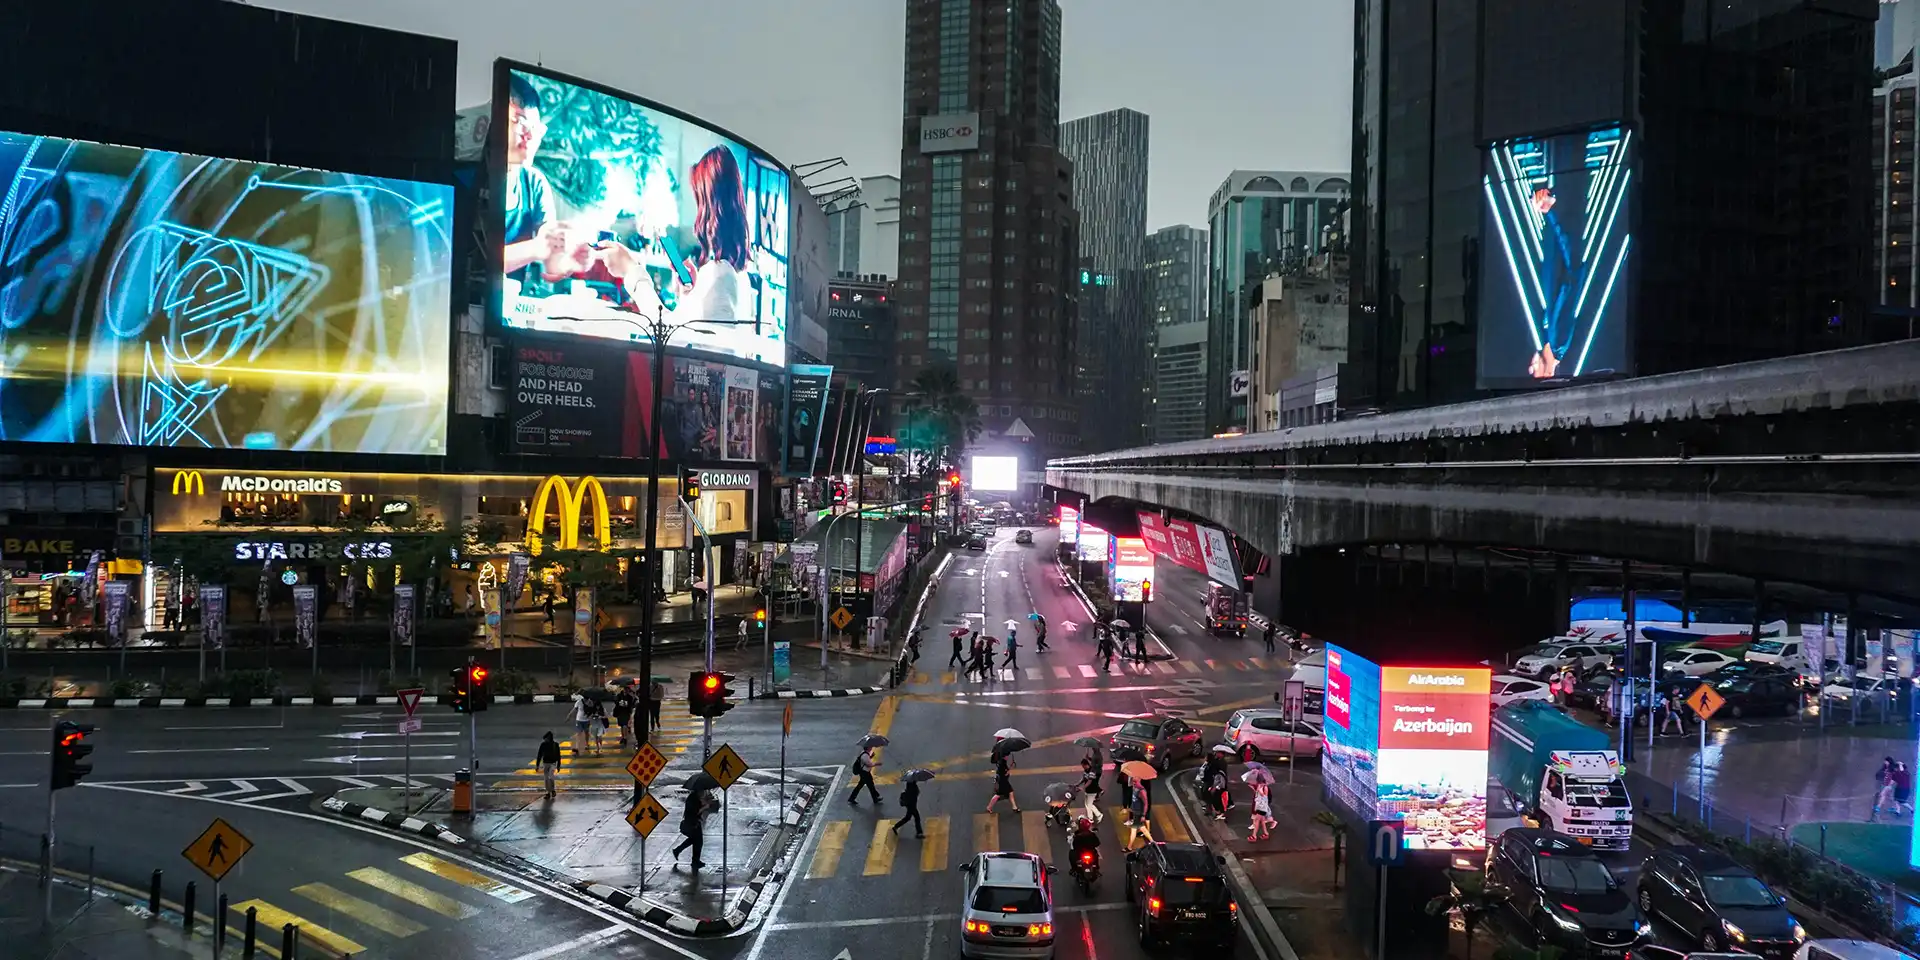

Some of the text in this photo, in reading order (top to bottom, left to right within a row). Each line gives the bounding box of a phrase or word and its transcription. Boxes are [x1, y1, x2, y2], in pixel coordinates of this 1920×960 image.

[923, 127, 955, 140] HSBC
[518, 361, 595, 381] FOR CHOICE
[518, 377, 583, 393] AND HEAD
[517, 391, 597, 408] OVER HEELS.
[564, 428, 592, 436] SHOWING
[221, 476, 343, 493] McDonald's
[701, 472, 751, 487] GIORDANO
[4, 537, 74, 554] BAKE
[1407, 674, 1465, 686] AirArabia
[1392, 717, 1473, 737] Azerbaijan
